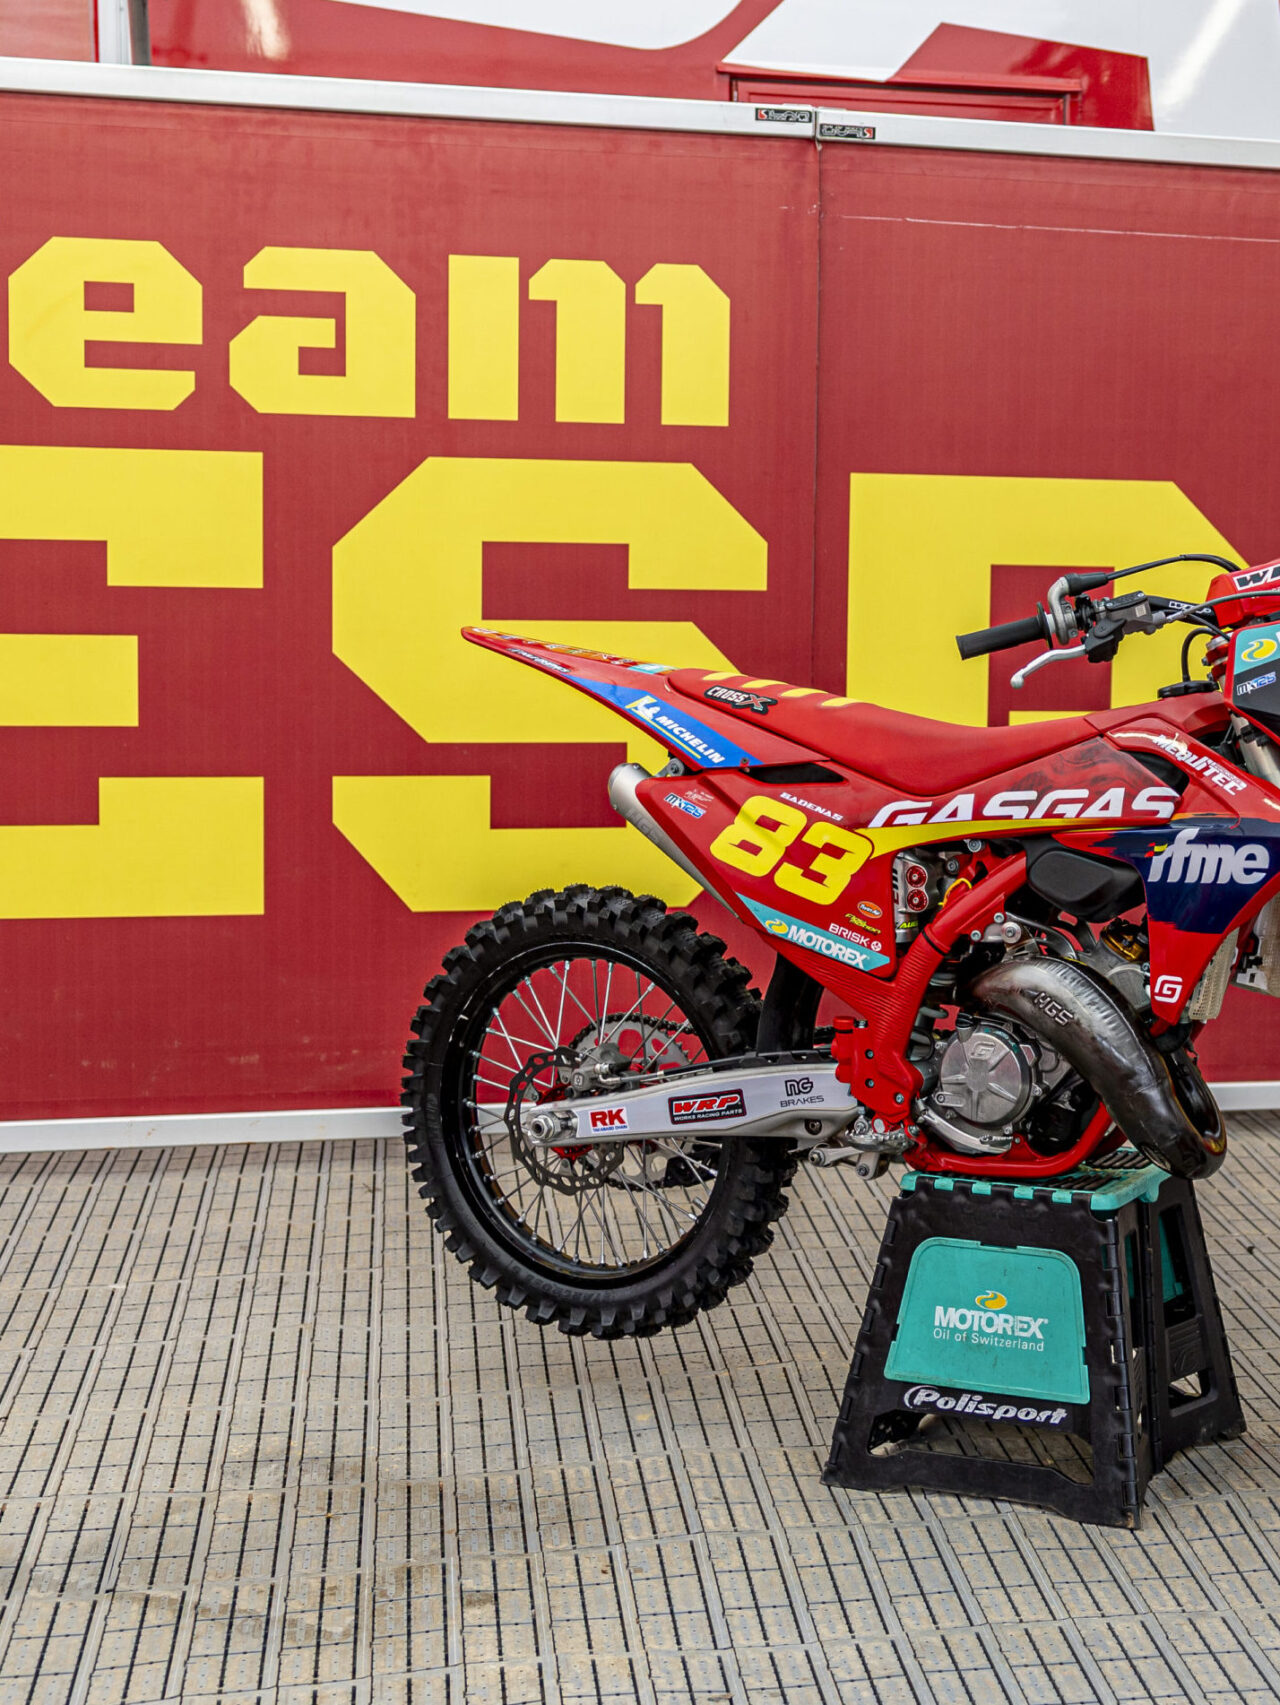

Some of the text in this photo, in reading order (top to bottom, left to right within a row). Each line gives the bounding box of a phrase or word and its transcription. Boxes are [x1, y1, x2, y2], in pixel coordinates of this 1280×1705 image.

[1237, 671, 1277, 695] MX125
[655, 715, 726, 765] MICHELIN
[1152, 735, 1247, 796] MEQUITEC
[664, 793, 706, 818] MX125
[780, 792, 844, 821] BADENAS
[868, 786, 1182, 828] GASGAS
[710, 795, 876, 906] 83
[1147, 827, 1270, 885] rfme
[788, 925, 869, 970] MOTOREX
[829, 923, 870, 947] BRISK
[1034, 991, 1074, 1027] HGS
[673, 1094, 740, 1115] WRP
[674, 1108, 743, 1122] WORKS RACING PARTS
[780, 1095, 824, 1108] BRAKES
[590, 1108, 625, 1128] RK
[934, 1305, 1044, 1340] MOTOREX
[933, 1328, 1044, 1352] Oil of Switzerland
[904, 1385, 1068, 1424] Polisport
